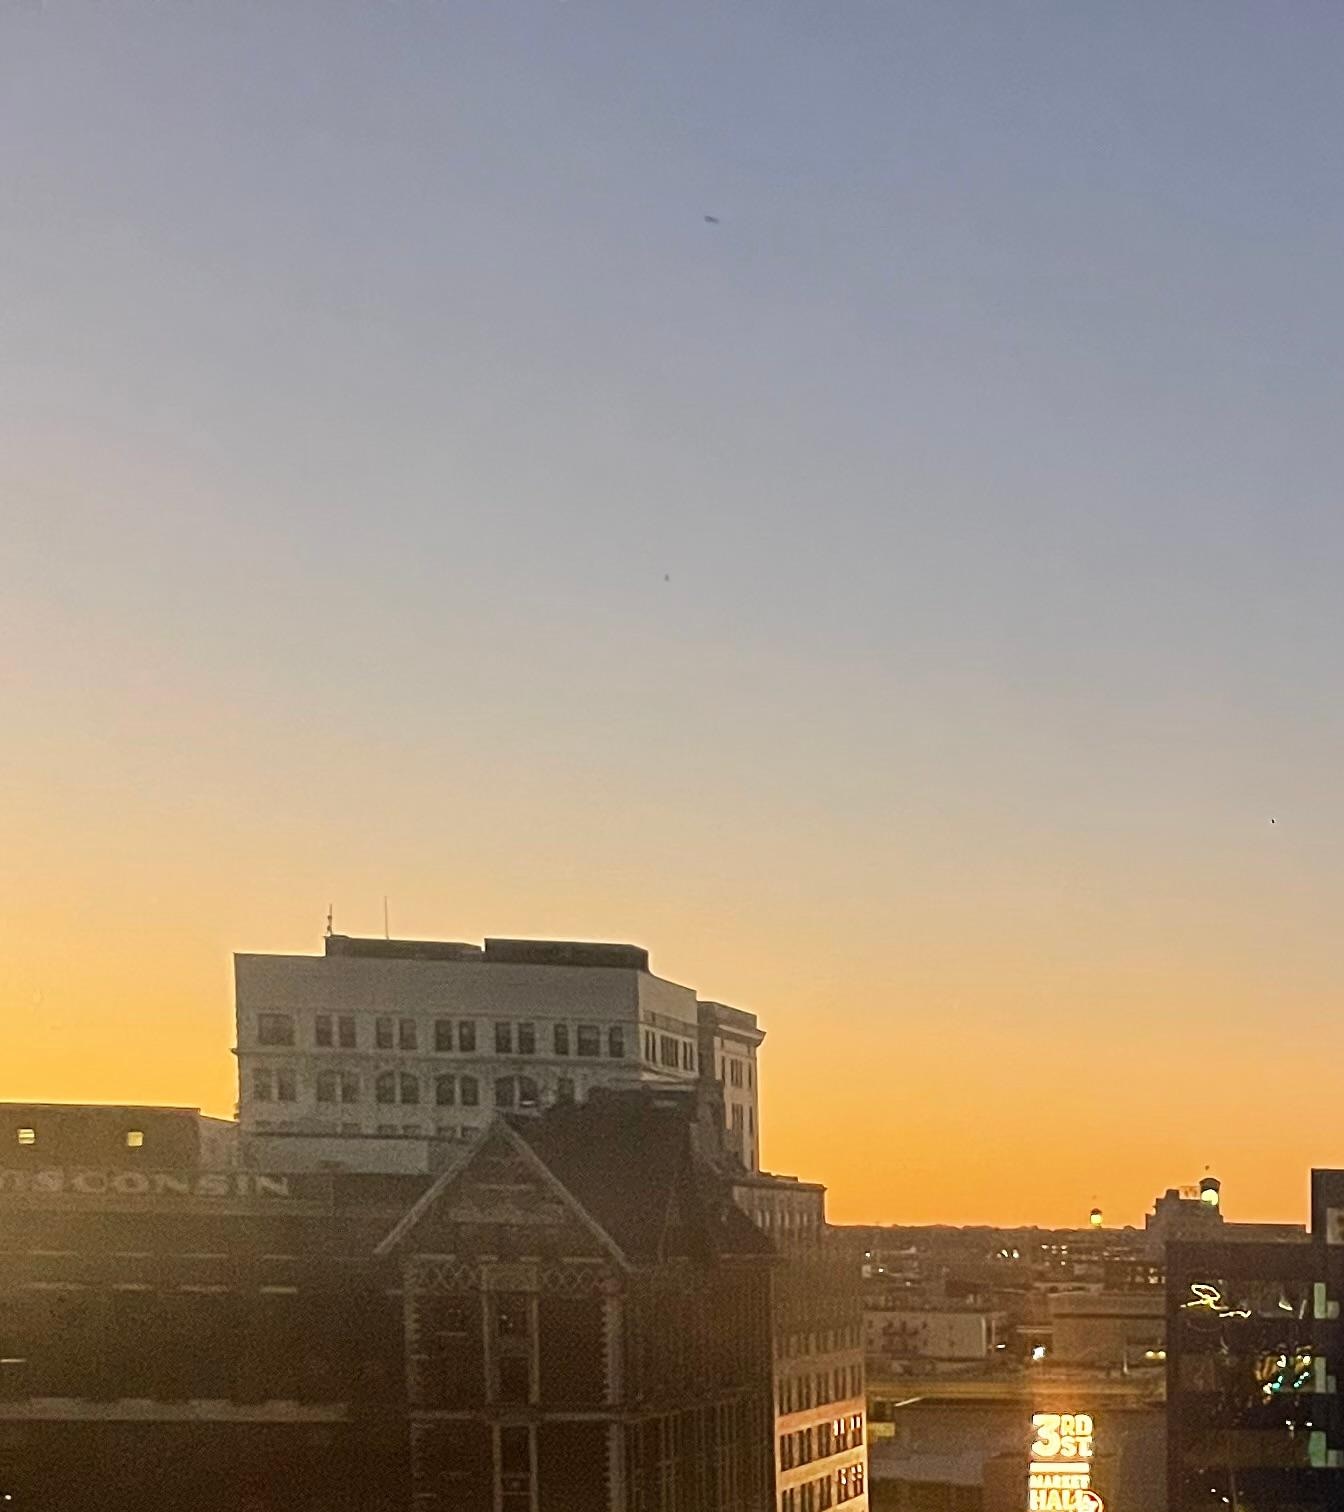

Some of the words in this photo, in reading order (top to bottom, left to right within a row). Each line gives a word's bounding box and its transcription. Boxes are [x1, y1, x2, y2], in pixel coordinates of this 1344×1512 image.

[0, 1170, 290, 1195] ISCONSIN
[1032, 1414, 1093, 1456] 3RD
[1029, 1474, 1090, 1489] MARKET
